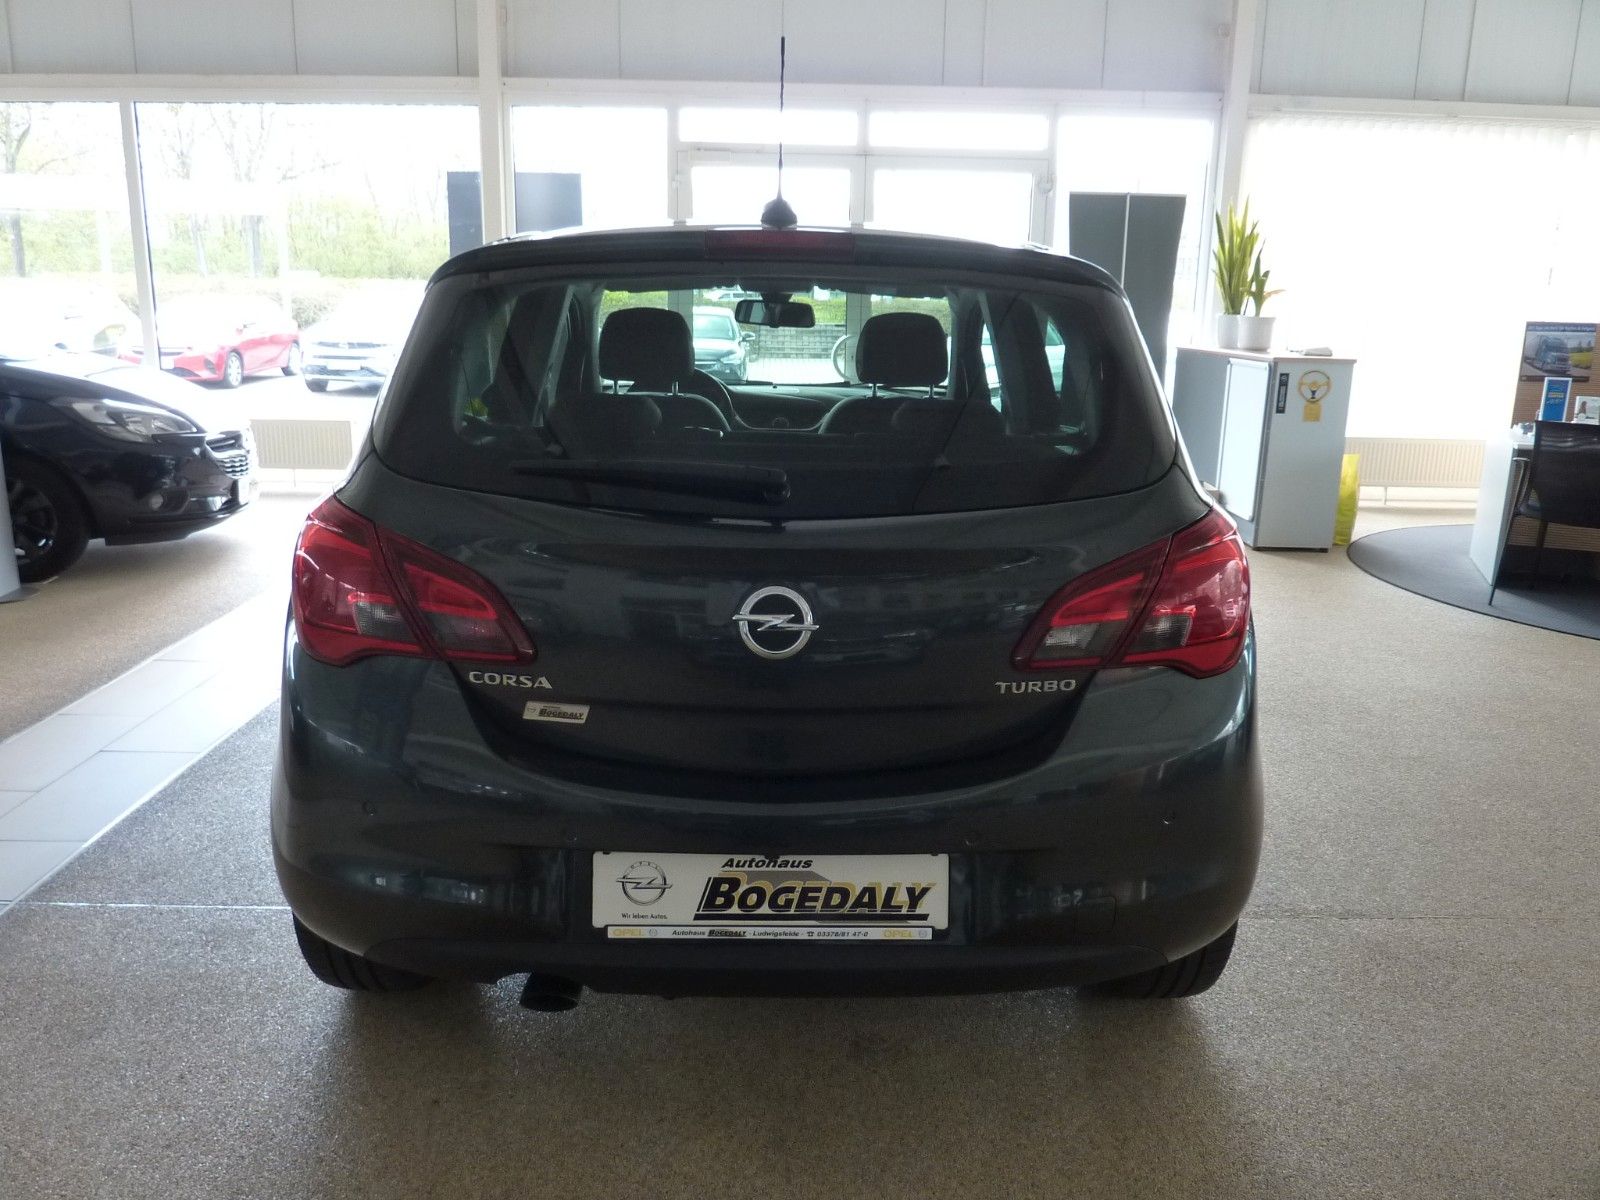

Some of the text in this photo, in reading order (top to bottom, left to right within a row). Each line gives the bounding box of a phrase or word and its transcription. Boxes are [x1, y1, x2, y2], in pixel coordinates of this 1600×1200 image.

[468, 671, 553, 690] CORSA
[994, 679, 1077, 694] TURBO
[722, 857, 814, 869] Autohaus
[698, 876, 933, 913] BOGEDALY
[613, 928, 643, 937] OPEL
[884, 930, 913, 938] OPEL
